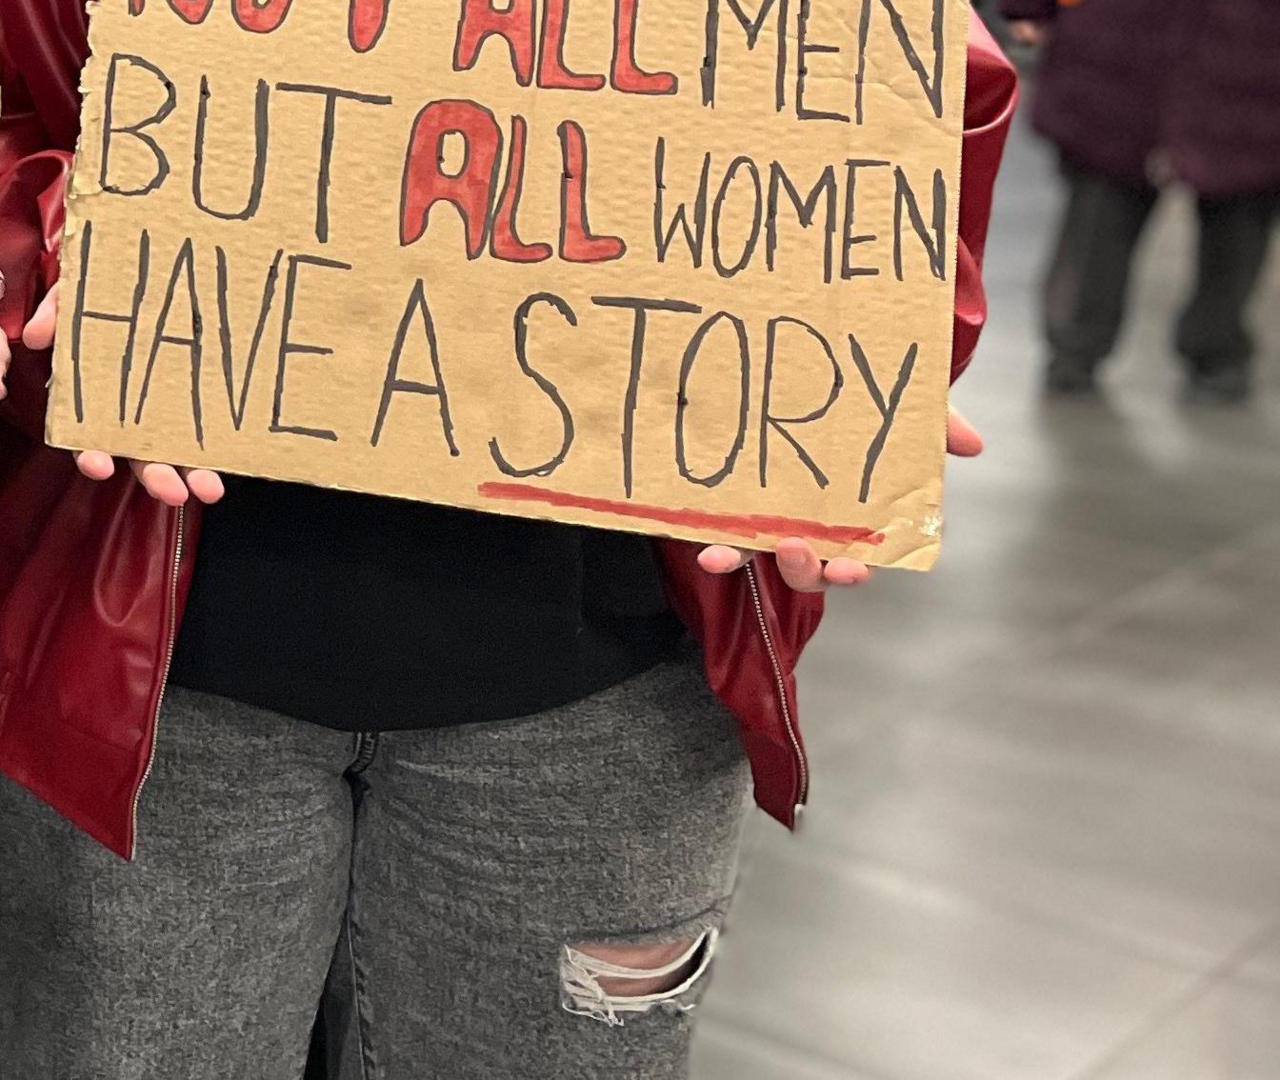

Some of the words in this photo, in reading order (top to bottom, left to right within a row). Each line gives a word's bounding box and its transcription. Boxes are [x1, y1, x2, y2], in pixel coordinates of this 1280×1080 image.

[98, 52, 392, 242] BUT
[400, 99, 626, 262] ALL
[654, 136, 945, 283] WOMEN
[72, 220, 353, 450] HAVE
[370, 278, 459, 457] A
[488, 291, 918, 503] STORY
